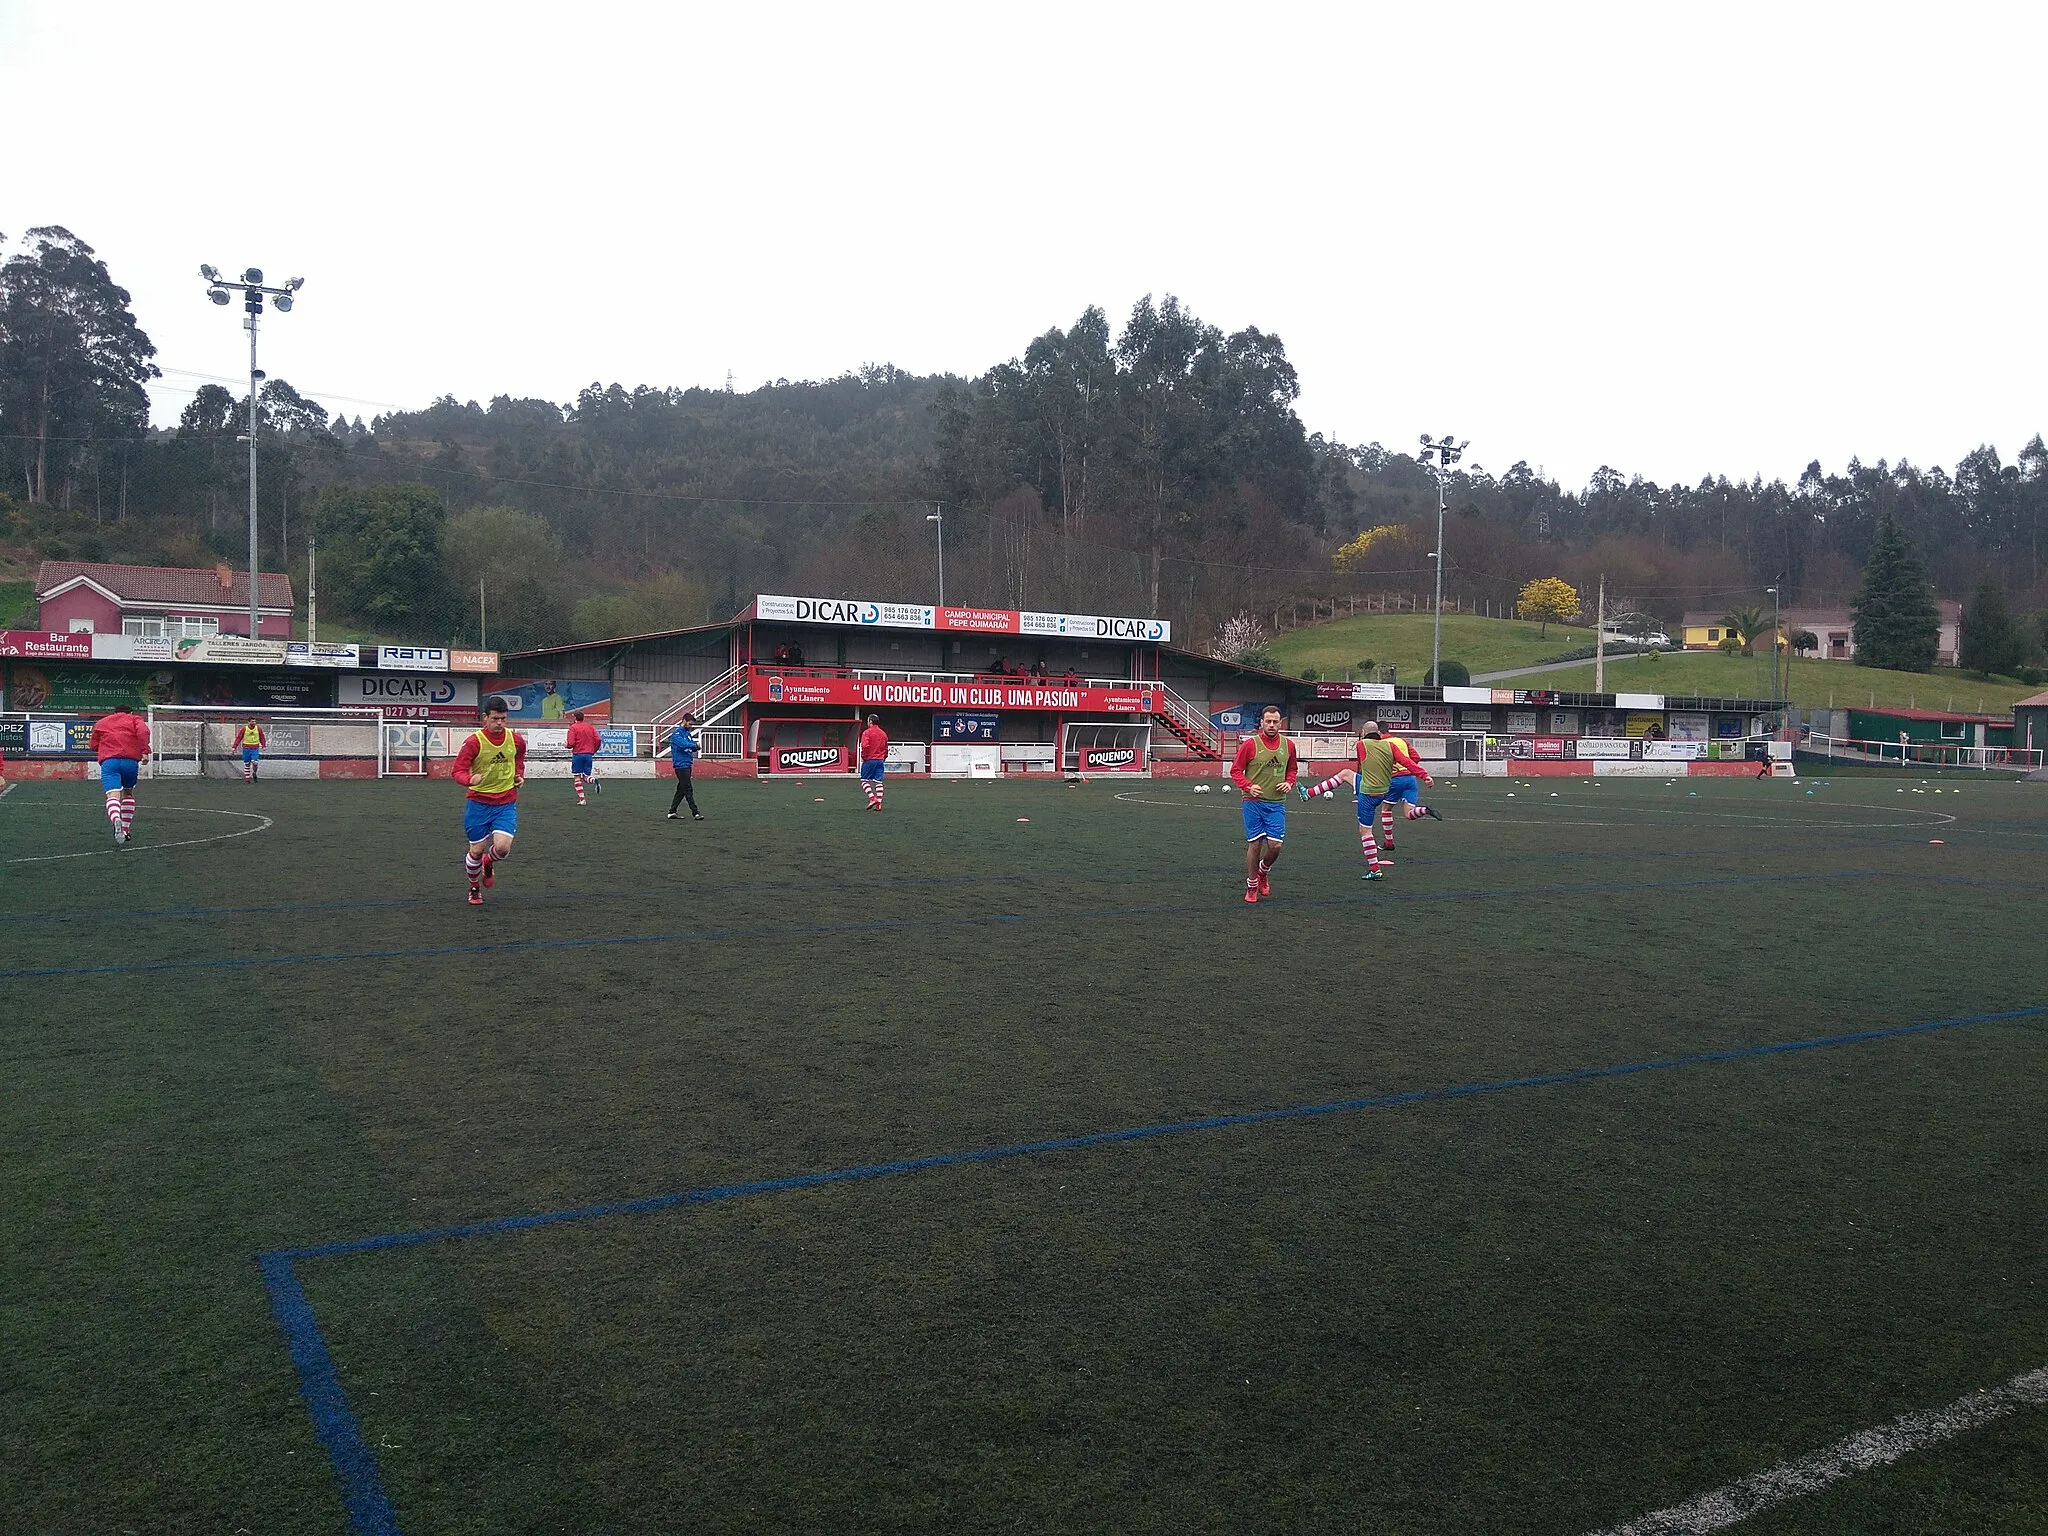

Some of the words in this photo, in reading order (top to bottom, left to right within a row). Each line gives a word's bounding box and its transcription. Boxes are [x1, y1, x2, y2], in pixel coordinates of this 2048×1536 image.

[761, 600, 795, 608] Construcciones
[796, 600, 859, 622] DICAR
[944, 610, 971, 619] CAMPO
[972, 612, 1011, 621] MUNICIPAL
[948, 619, 968, 627] PEPE
[969, 619, 1009, 629] QUIMARÁN
[1096, 619, 1146, 638] DICAR
[50, 633, 69, 642] Bar
[25, 641, 90, 652] Restaurante
[462, 655, 495, 664] NACEX
[362, 678, 428, 697] DICAR
[784, 685, 830, 694] Ayuntamiento
[863, 684, 882, 702] UN
[885, 686, 946, 705] CONCEJO,
[949, 688, 969, 704] UN
[970, 689, 1005, 707] CLUB,
[1008, 690, 1033, 706] UNA
[1035, 688, 1078, 707] PASIÓN
[1104, 696, 1141, 704] Ayuntamiento
[385, 706, 403, 716] 027
[1379, 709, 1400, 717] DICAR
[1306, 711, 1350, 725] OQUENDO
[780, 748, 838, 765] OQUENDO
[1088, 750, 1134, 765] OQUENDO
